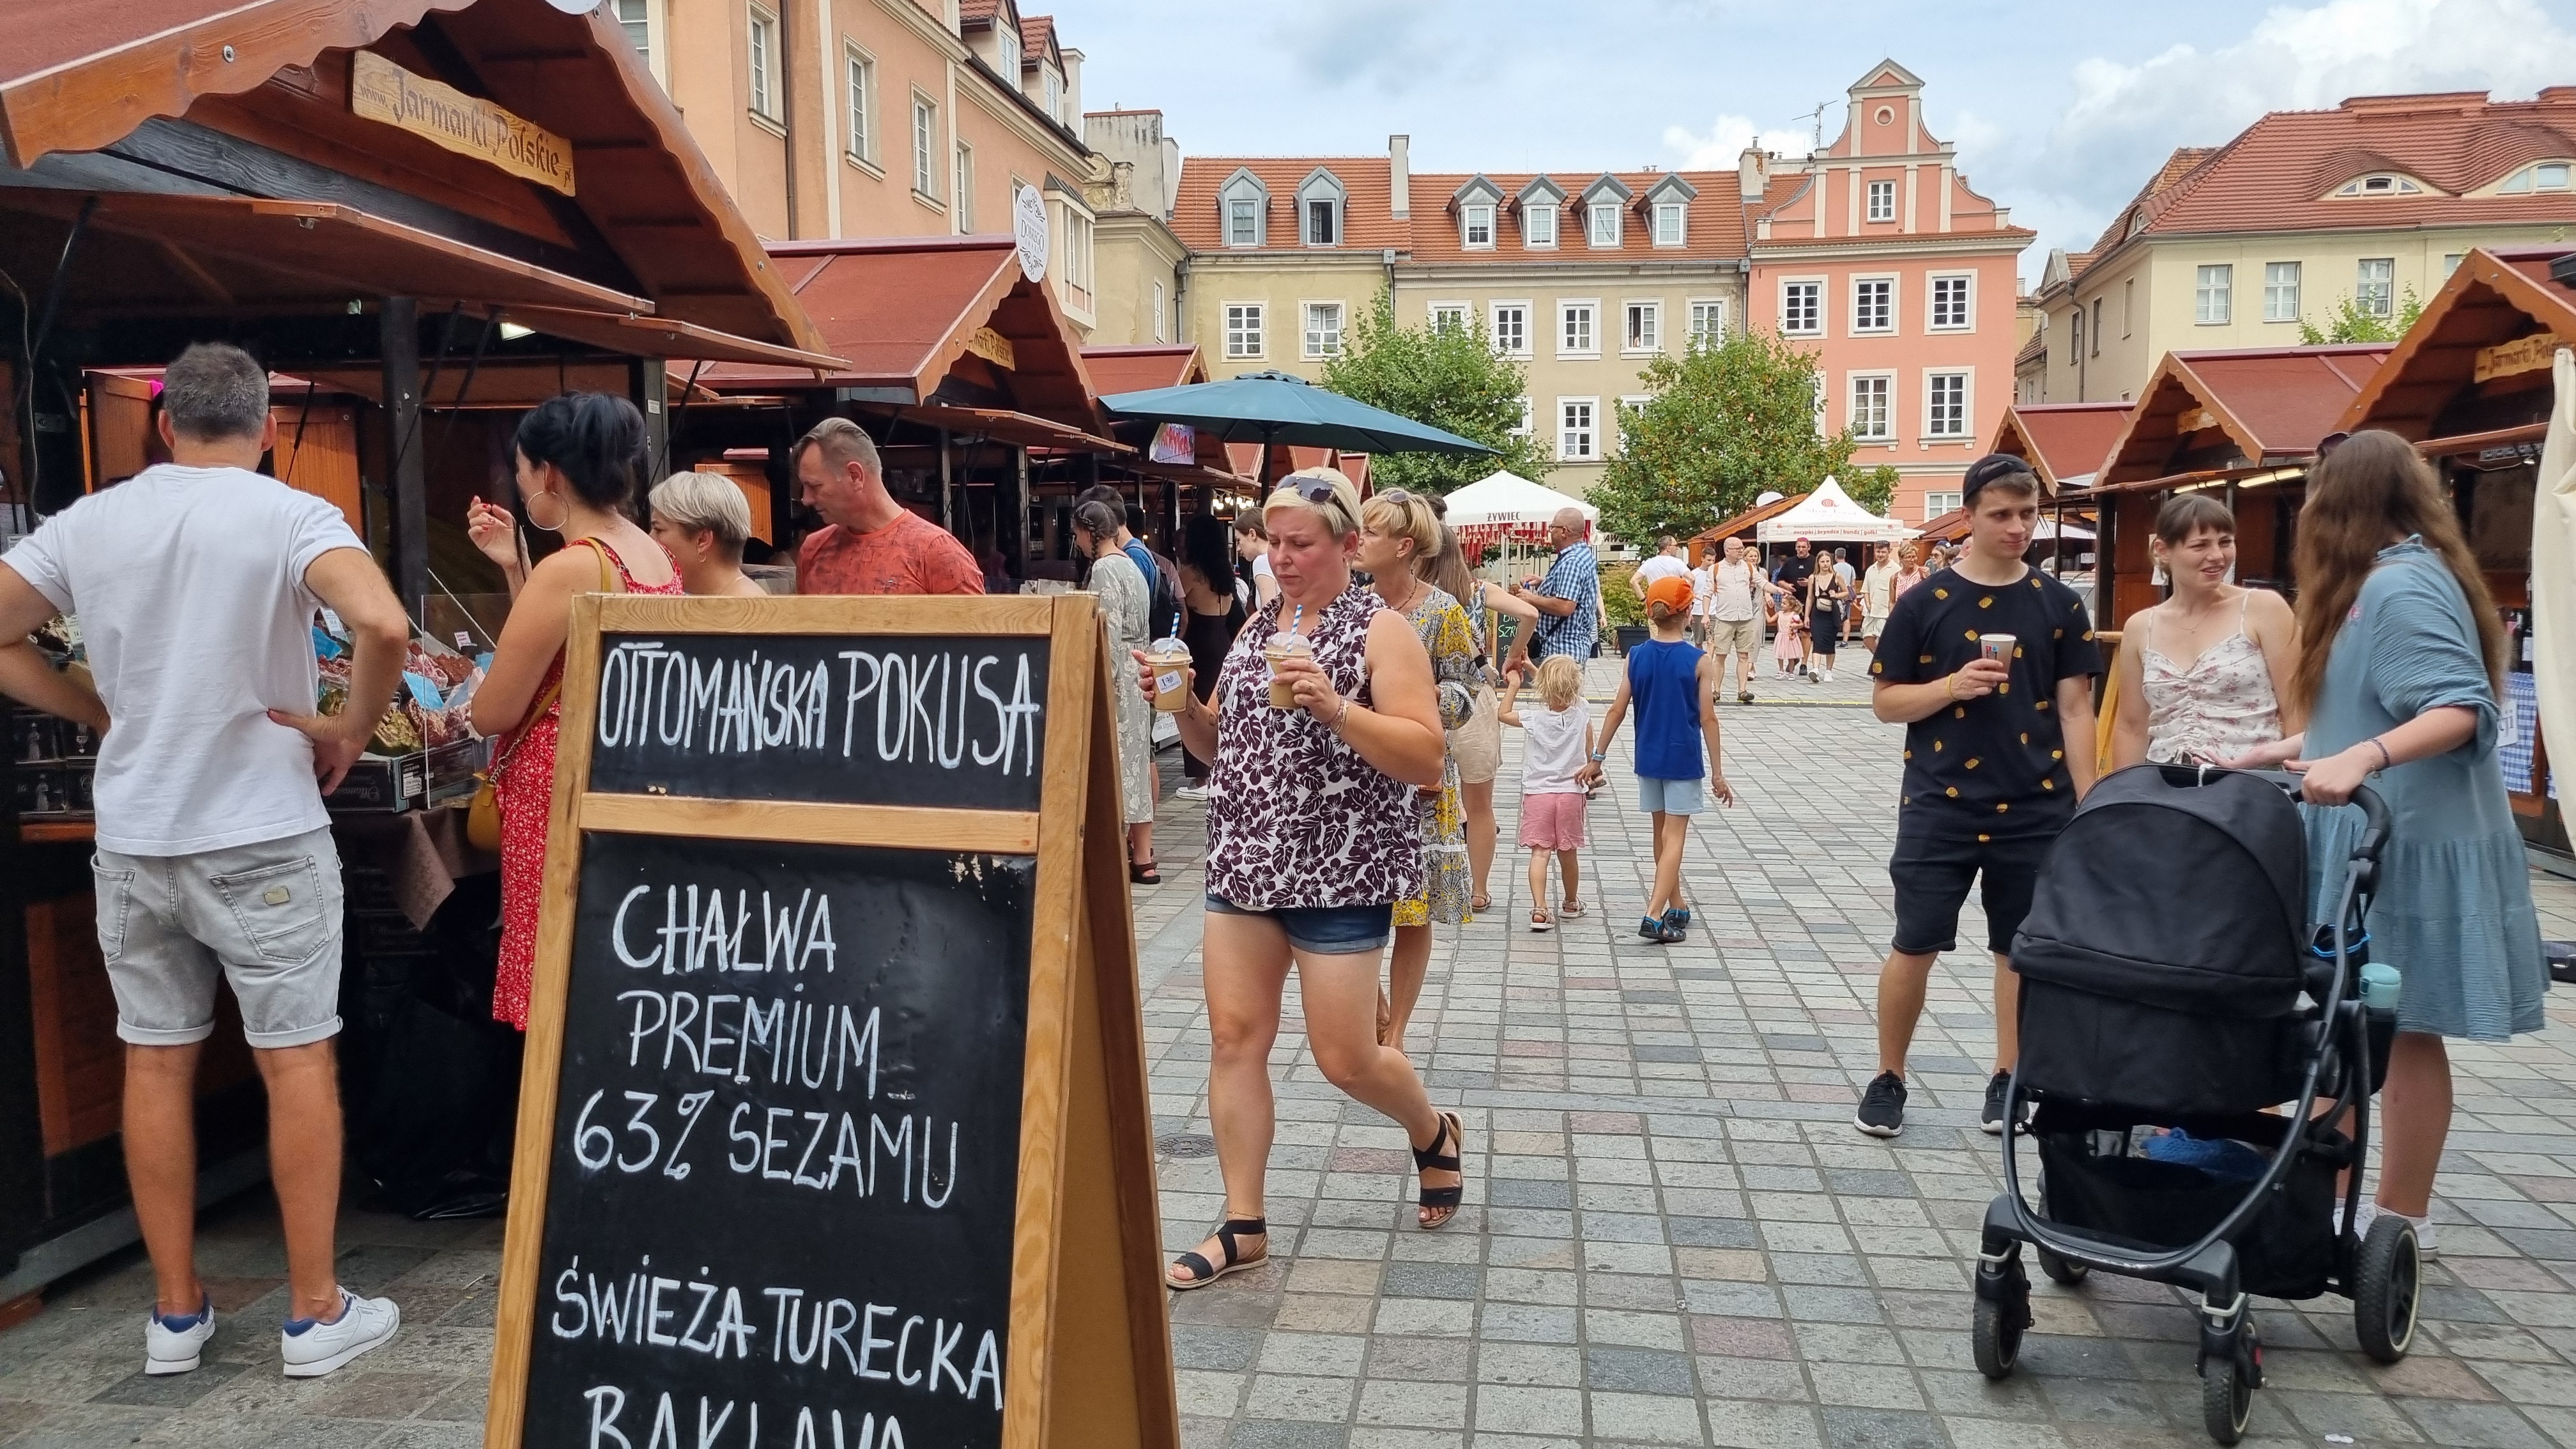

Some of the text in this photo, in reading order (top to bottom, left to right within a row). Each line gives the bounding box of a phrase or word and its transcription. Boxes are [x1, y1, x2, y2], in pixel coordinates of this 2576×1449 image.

[392, 68, 487, 148] Jarmarki
[492, 113, 560, 176] Polskie
[1021, 219, 1045, 252] DOBREGO
[1487, 511, 1521, 522] ŻYWIEC
[599, 641, 1040, 777] OTTOMAŃSKA POKUSA
[612, 884, 836, 976] CHAŁWA
[574, 1089, 958, 1209] 63% SEZAMU
[763, 1287, 1004, 1411] TURECKA
